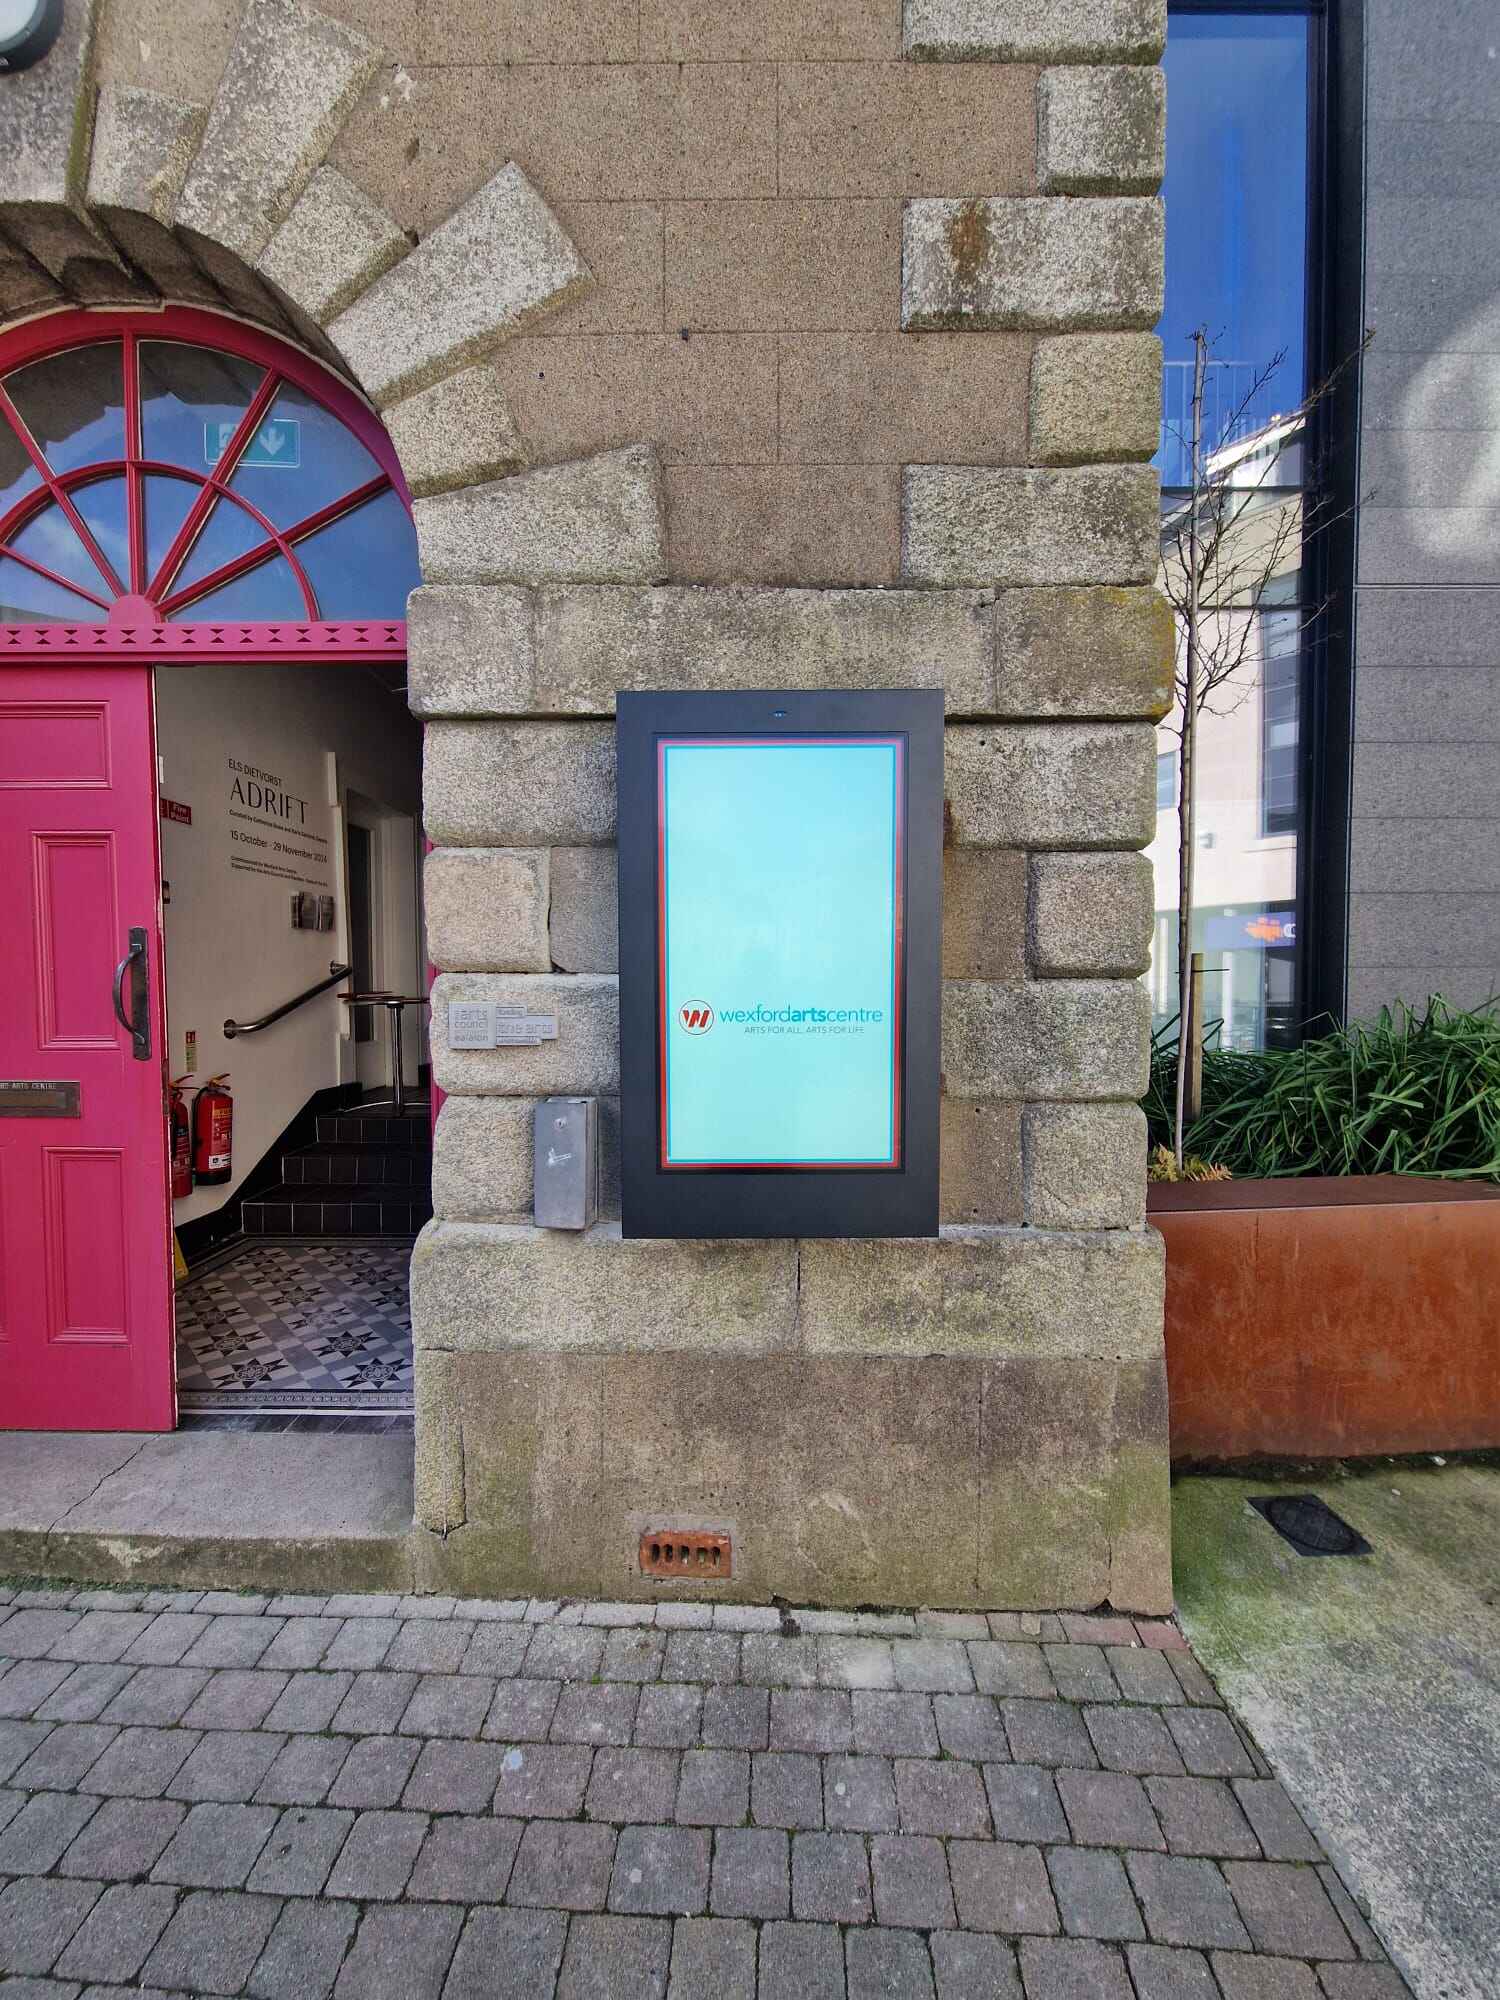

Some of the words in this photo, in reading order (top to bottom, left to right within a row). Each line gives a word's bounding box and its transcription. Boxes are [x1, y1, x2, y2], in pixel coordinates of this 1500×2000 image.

[228, 758, 243, 773] ELS
[230, 776, 309, 825] ADRIFT
[230, 829, 239, 841] 15
[240, 831, 267, 849] October
[273, 841, 282, 853] 29
[282, 843, 313, 861] November
[719, 1002, 883, 1023] wexfordartscentre
[744, 1025, 766, 1034] ARTS
[767, 1025, 785, 1034] FOR
[806, 1025, 827, 1034] ARTS
[829, 1025, 846, 1034] FOR
[848, 1025, 865, 1034] LIFE
